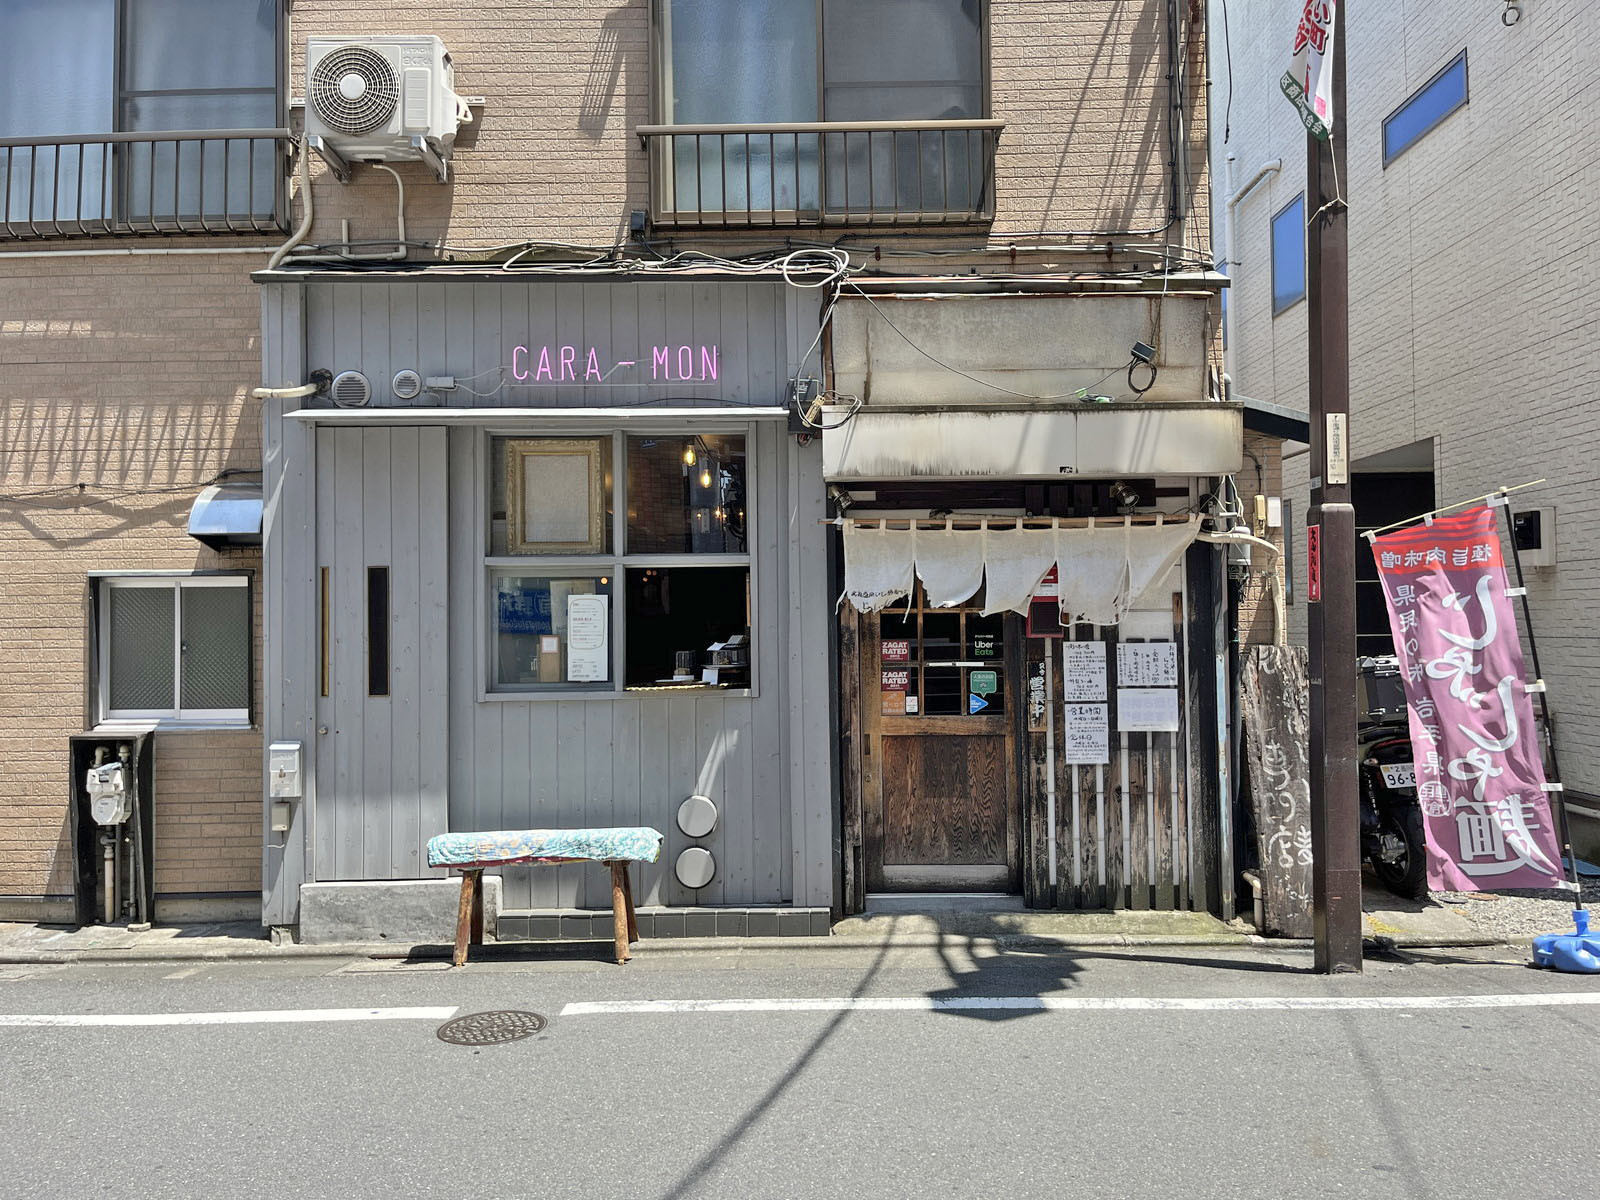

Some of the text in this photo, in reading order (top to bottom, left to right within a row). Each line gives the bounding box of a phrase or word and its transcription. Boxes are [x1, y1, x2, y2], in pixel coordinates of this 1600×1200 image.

[511, 344, 602, 382] CARA
[652, 345, 718, 381] MON
[882, 641, 908, 649] ZAGAT
[974, 640, 994, 649] Uber
[974, 648, 994, 656] Eats
[882, 671, 908, 679] ZAGAT
